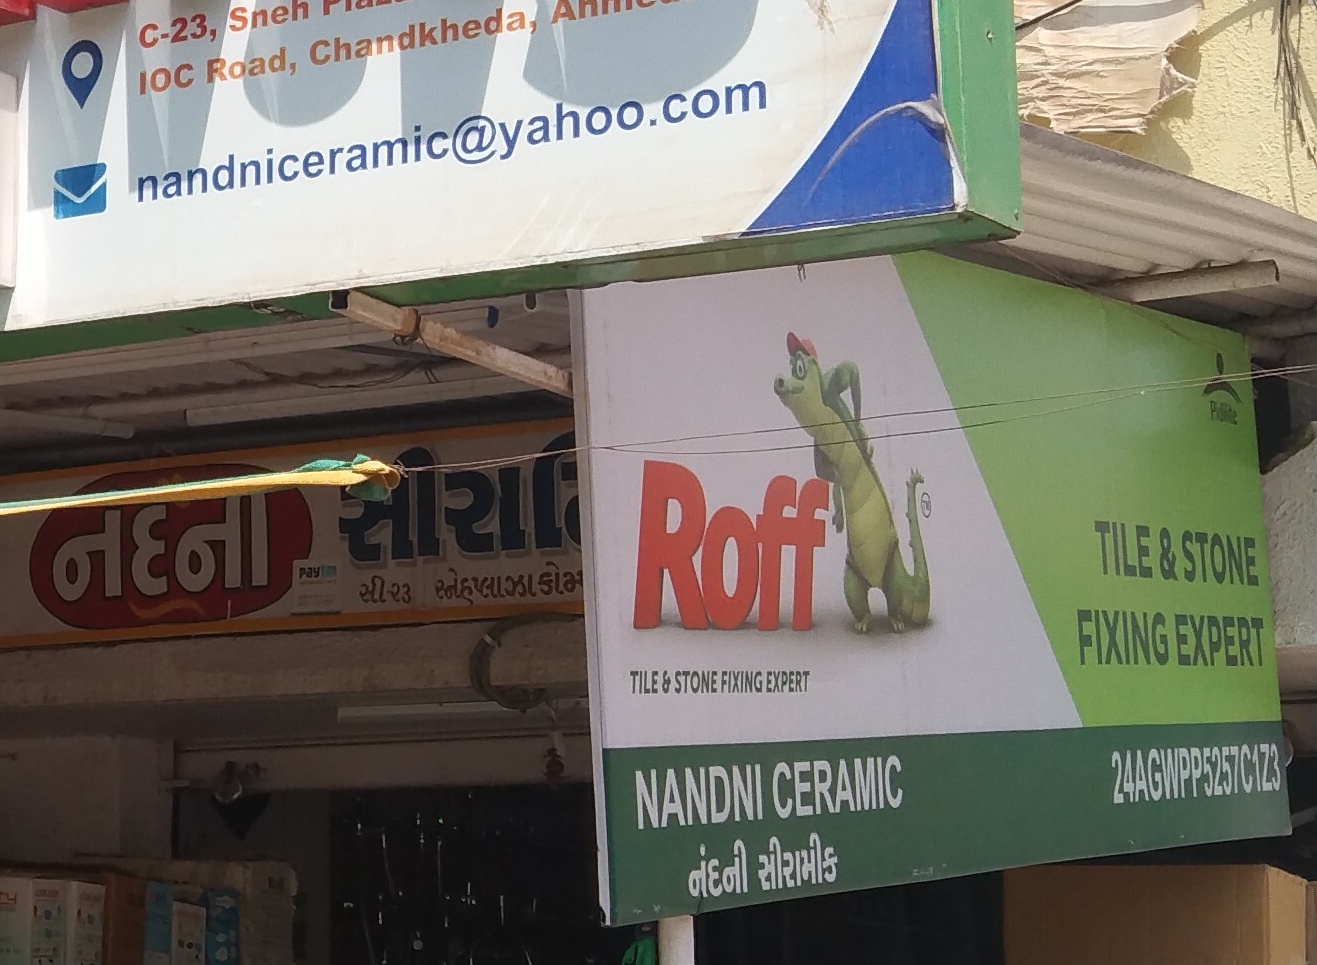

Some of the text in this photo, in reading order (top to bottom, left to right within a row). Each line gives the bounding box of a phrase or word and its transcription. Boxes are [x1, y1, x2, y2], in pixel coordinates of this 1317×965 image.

[137, 13, 218, 50] C-23,
[137, 63, 195, 96] IOC
[206, 48, 299, 87] Road,
[309, 4, 539, 67] Chandkheda,
[136, 77, 768, 204] nandniceramic@yahoo.com
[633, 460, 829, 632] Roff
[1094, 519, 1260, 587] TILE & STONE
[1077, 608, 1265, 667] FIXING EXPERT
[630, 669, 810, 694] TILE & STONE FIXING EXPERT
[634, 743, 1281, 830] NANDNI CERAMIC 24AGWPP5257C1Z3
[688, 832, 838, 898] નંદની સીરામીક
